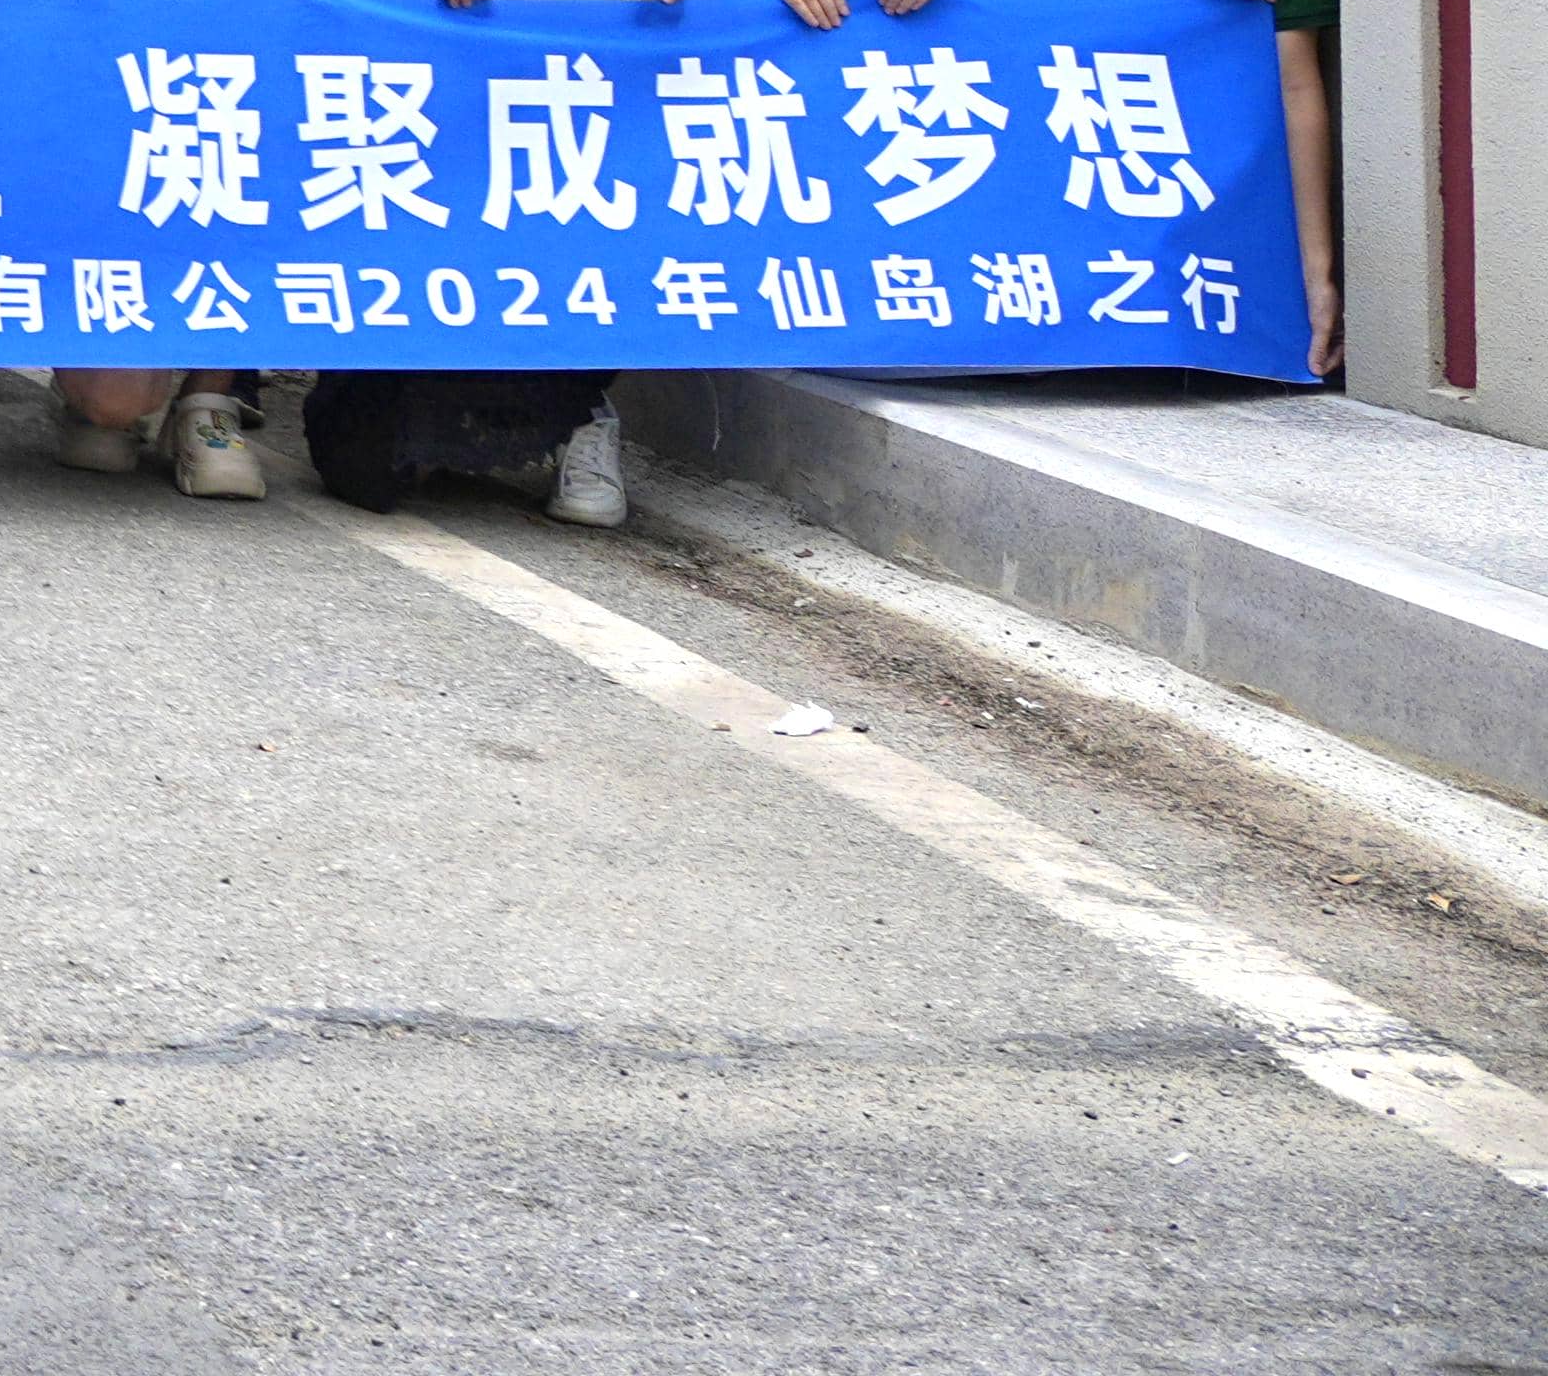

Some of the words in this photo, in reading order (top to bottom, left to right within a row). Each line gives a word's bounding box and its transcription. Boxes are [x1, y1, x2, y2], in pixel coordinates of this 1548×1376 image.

[117, 45, 1216, 231] 凝聚成就梦想
